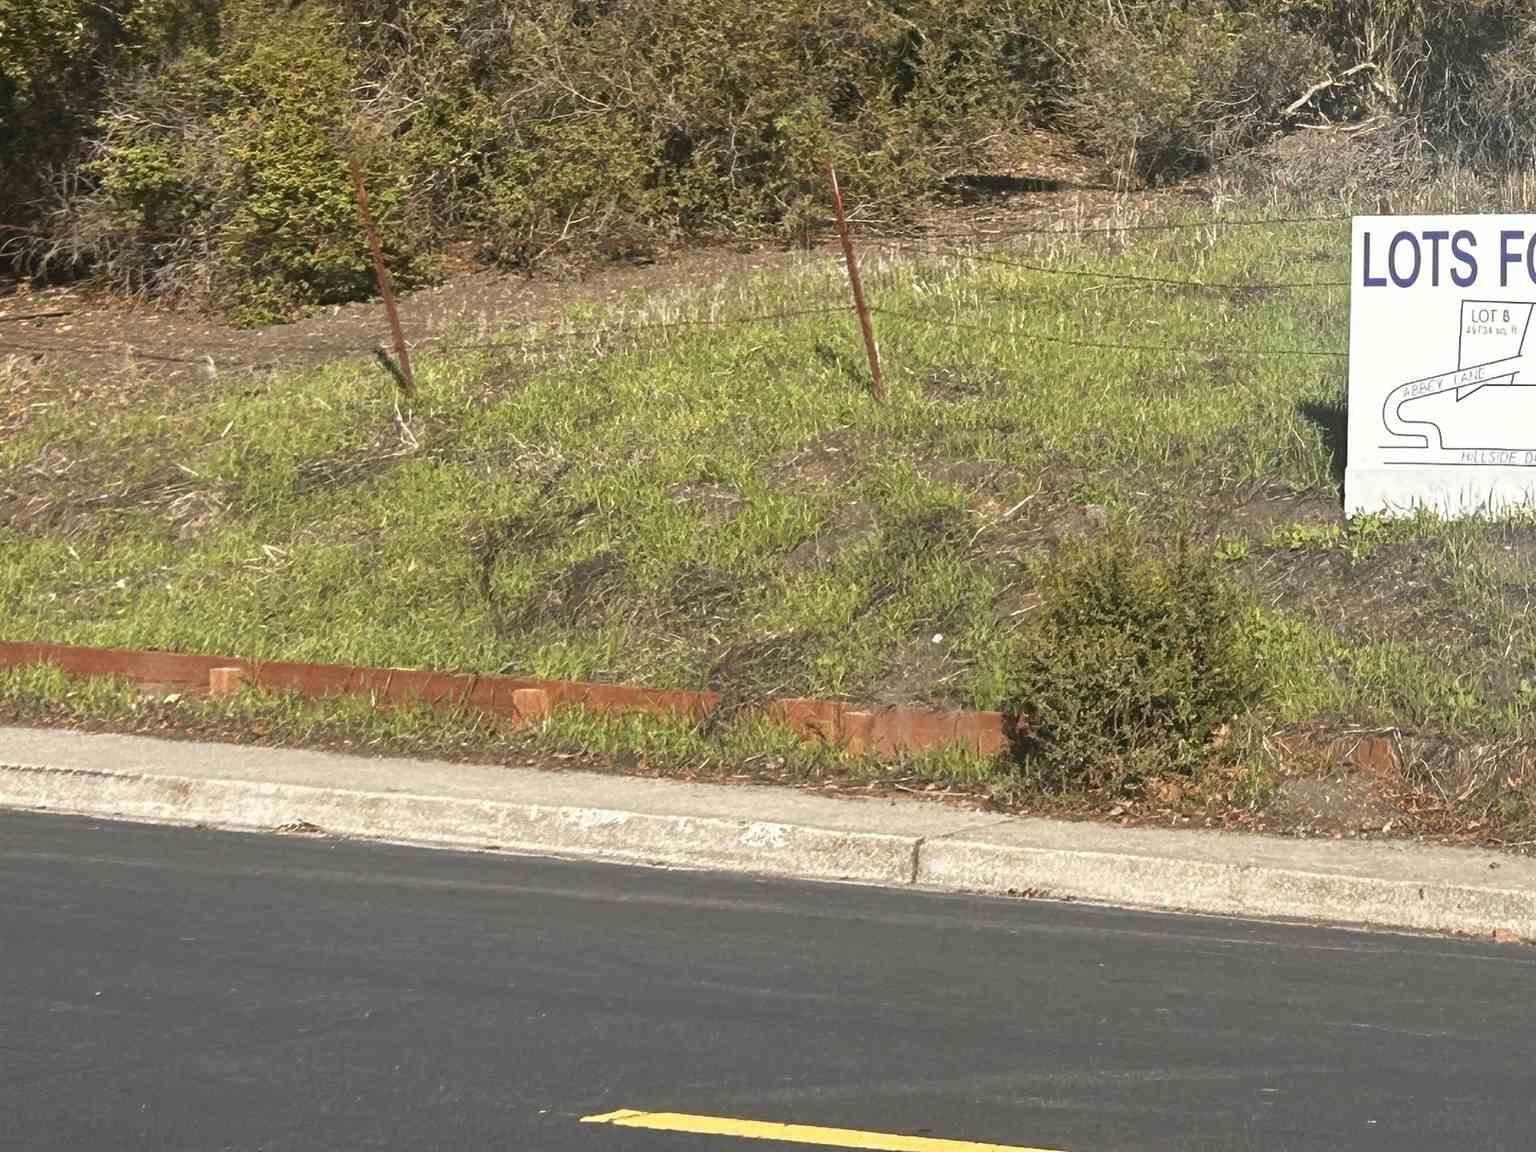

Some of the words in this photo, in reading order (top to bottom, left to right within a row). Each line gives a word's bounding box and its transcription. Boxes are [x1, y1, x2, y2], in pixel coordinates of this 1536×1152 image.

[1363, 229, 1478, 288] LOTS
[1471, 309, 1498, 323] LOT
[1403, 378, 1443, 397] ABBEY
[1453, 368, 1486, 386] LANE
[1461, 450, 1518, 464] HILLSIDE
